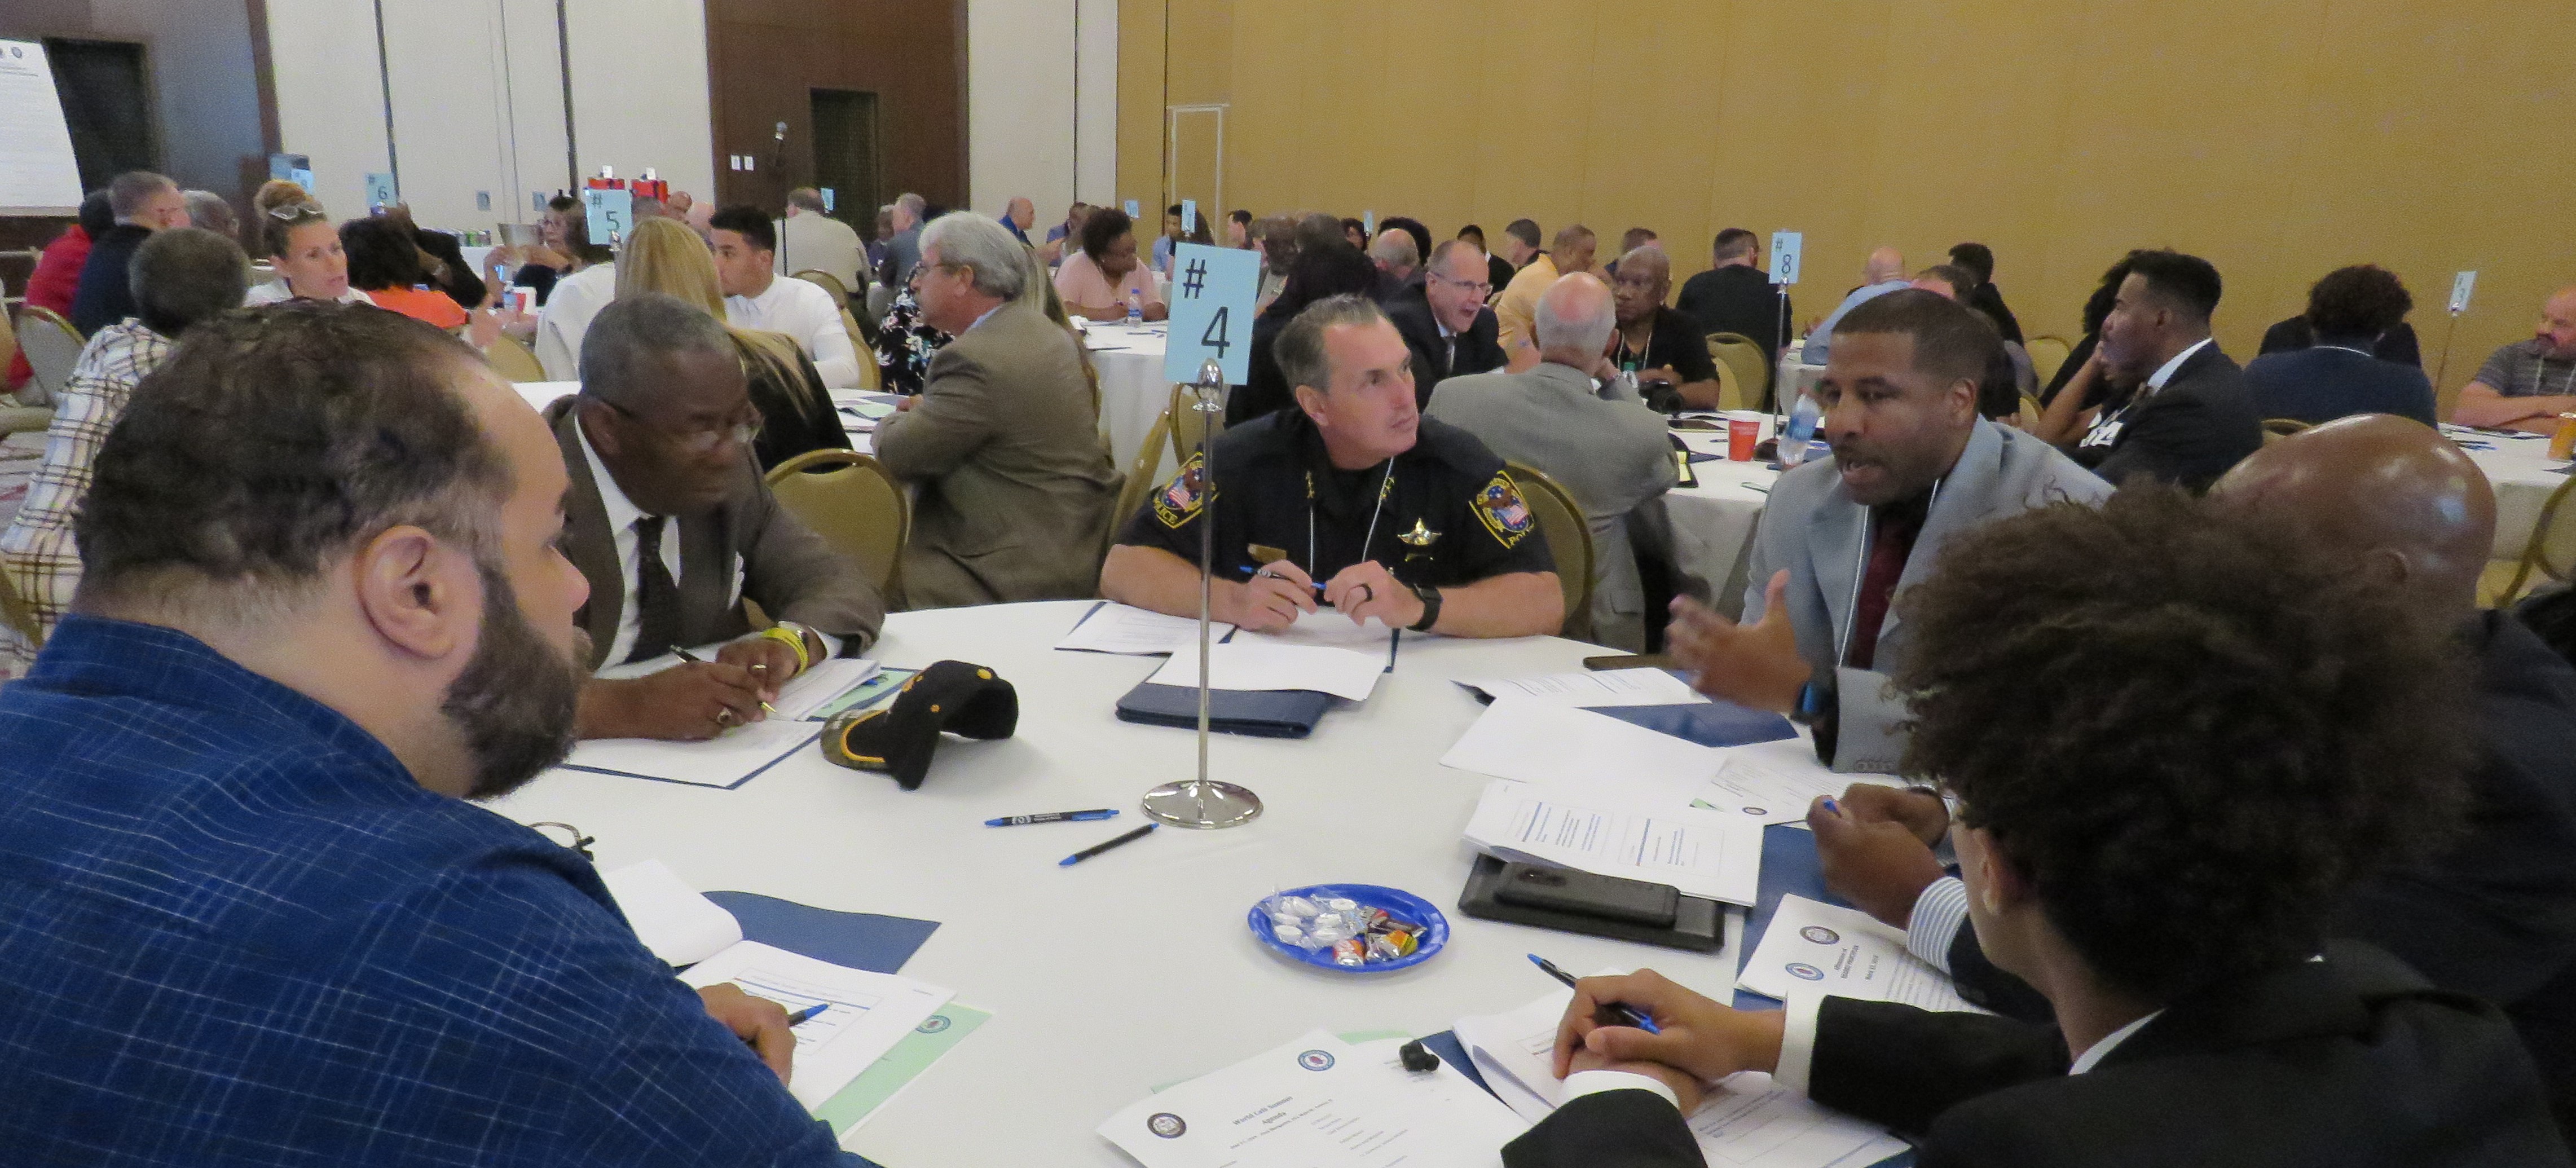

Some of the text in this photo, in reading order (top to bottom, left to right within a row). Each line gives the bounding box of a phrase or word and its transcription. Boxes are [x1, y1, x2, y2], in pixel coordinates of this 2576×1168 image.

[377, 186, 387, 200] 6
[591, 192, 603, 209] #
[606, 210, 620, 231] 5
[1781, 254, 1791, 274] 8
[1183, 258, 1207, 299] #
[1201, 306, 1230, 359] 4
[1261, 1111, 1287, 1126] Agenda
